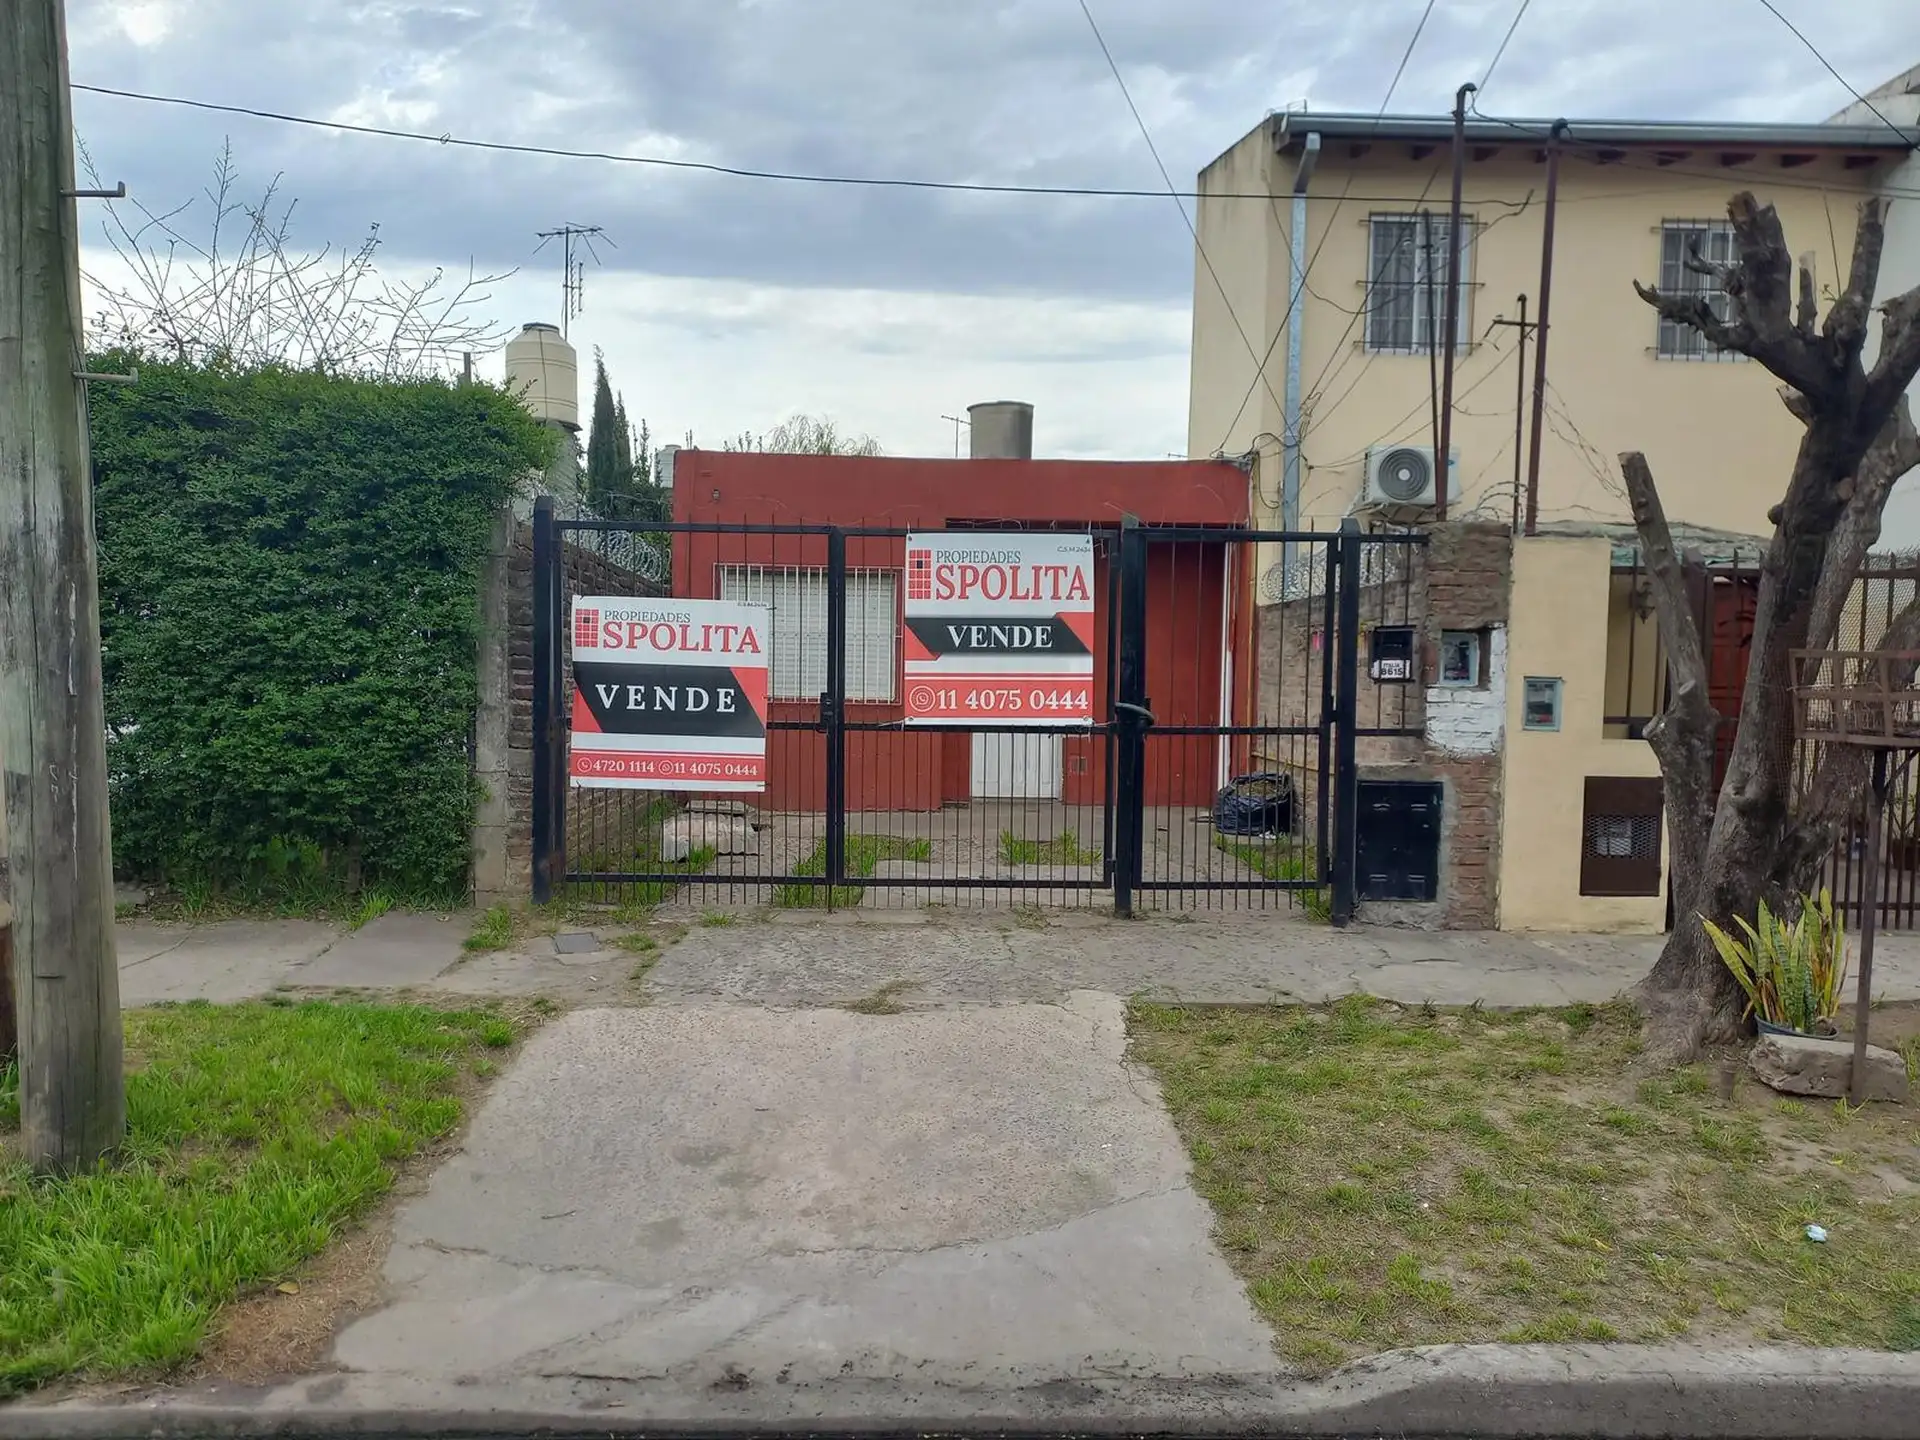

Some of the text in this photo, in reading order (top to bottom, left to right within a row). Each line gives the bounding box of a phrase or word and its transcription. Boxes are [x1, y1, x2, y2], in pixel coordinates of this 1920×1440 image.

[936, 550, 1021, 564] PROPIEDADES
[935, 564, 1090, 600] SPOLITA
[604, 610, 691, 623] PROPIEDADES
[602, 621, 761, 653] SPOLITA
[947, 625, 1053, 648] VENDE
[595, 684, 736, 713] VENDE
[936, 689, 1088, 710] 11 4075 0444
[592, 760, 757, 776] 4720 1114 11 4075 0444
